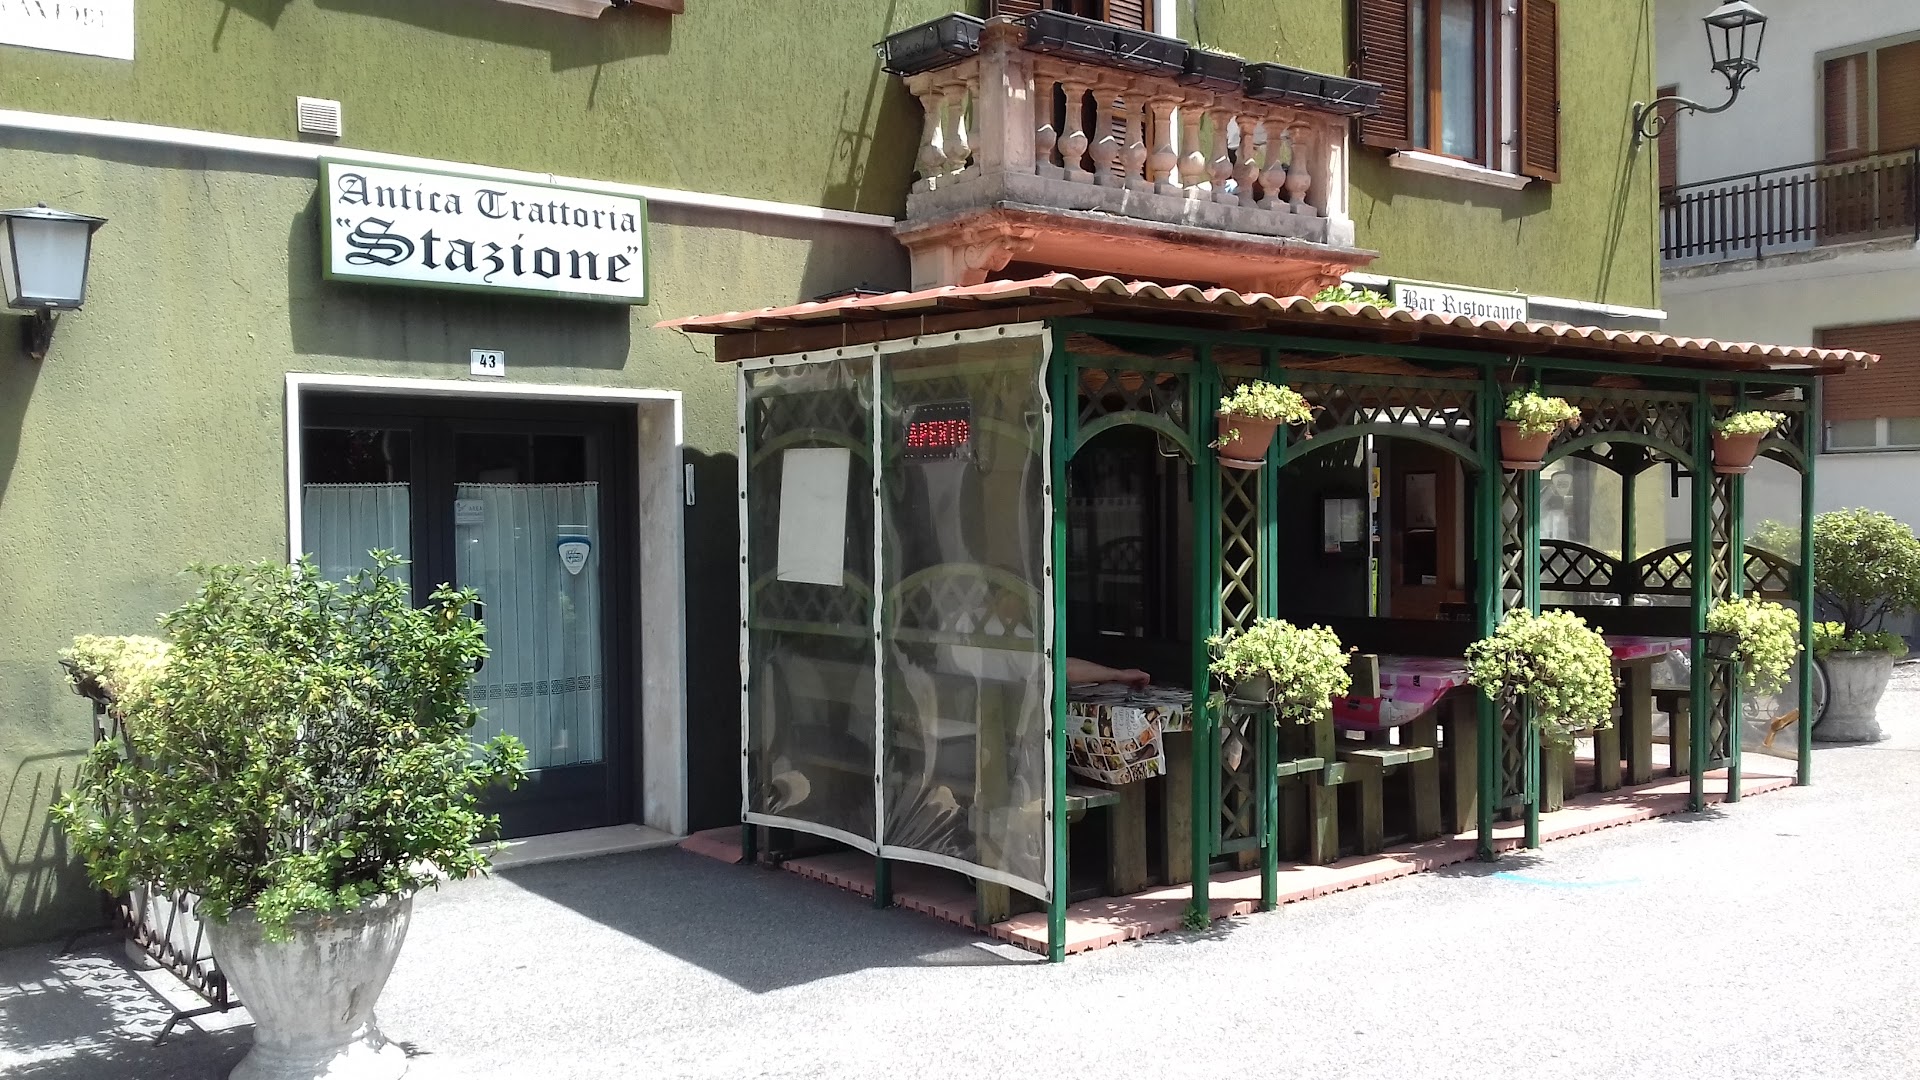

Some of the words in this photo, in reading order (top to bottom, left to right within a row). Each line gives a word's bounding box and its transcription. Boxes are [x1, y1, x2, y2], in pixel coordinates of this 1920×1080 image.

[338, 173, 463, 215] Antica
[474, 188, 637, 234] Trattoria
[1402, 288, 1436, 312] Bar
[1442, 293, 1522, 321] Ristorante
[480, 354, 496, 368] 43
[907, 419, 968, 447] APERTO
